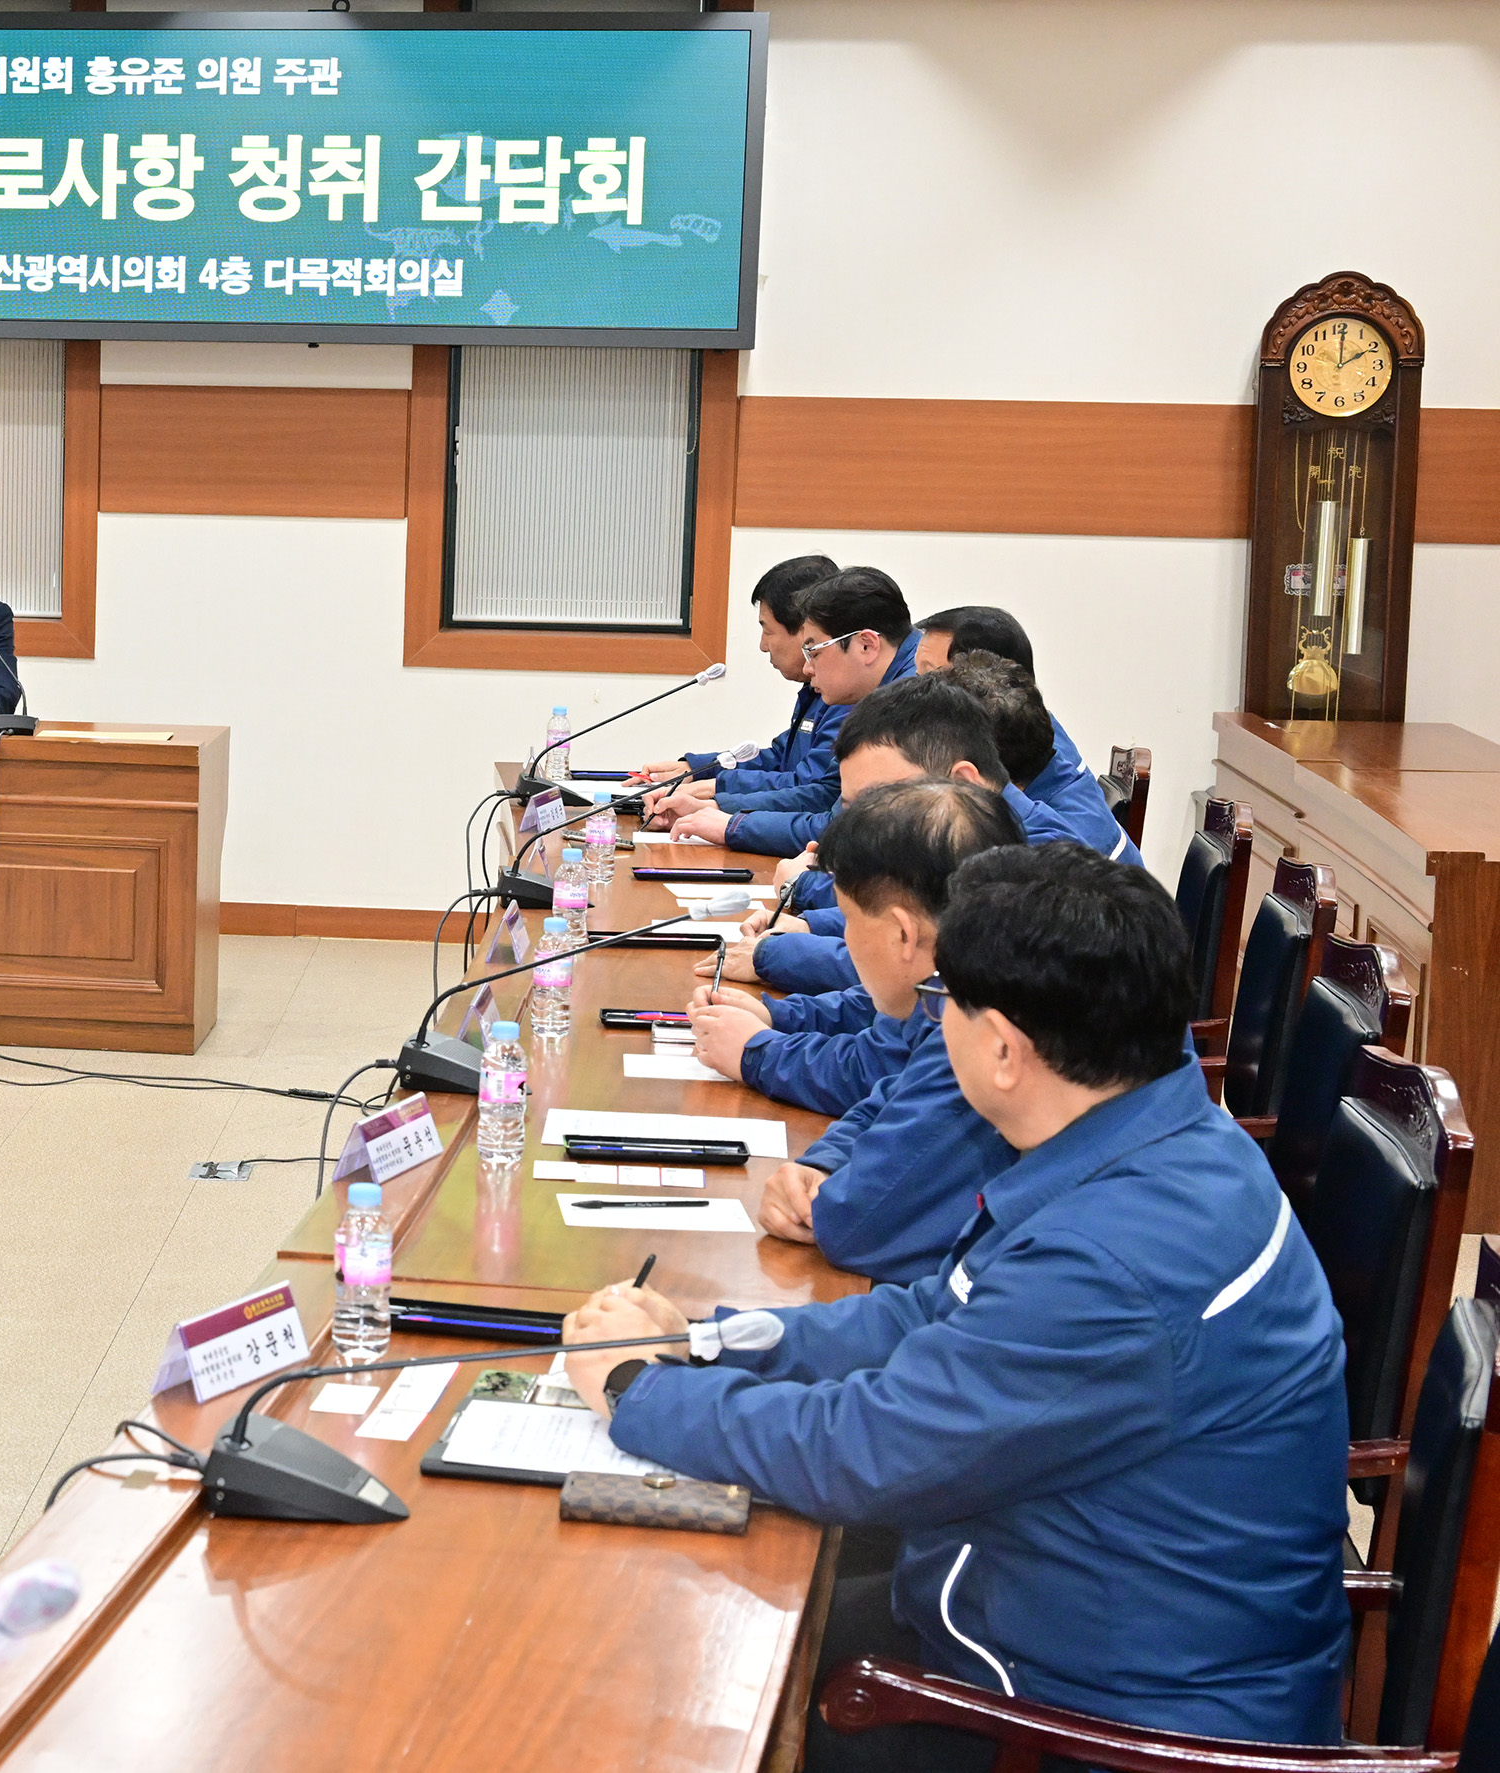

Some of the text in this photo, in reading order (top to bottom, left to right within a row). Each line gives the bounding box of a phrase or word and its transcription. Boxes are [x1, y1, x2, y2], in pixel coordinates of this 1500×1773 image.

[85, 56, 185, 95] 홍유준
[196, 57, 261, 95] 의원
[273, 57, 342, 95] 주관
[229, 134, 381, 223] 청취
[414, 135, 646, 225] 간담회
[199, 255, 253, 296] 4층
[264, 256, 464, 297] 다목적회의실
[1332, 322, 1348, 335] 12
[1314, 329, 1327, 341] 11
[1301, 344, 1315, 356] 10
[1368, 341, 1379, 353] 2
[1296, 361, 1307, 373] 9
[1372, 359, 1384, 371] 3
[1301, 378, 1313, 390] 8
[1365, 376, 1377, 387] 4
[1315, 391, 1326, 402] 7
[1334, 396, 1345, 408] 6
[1353, 390, 1365, 402] 5
